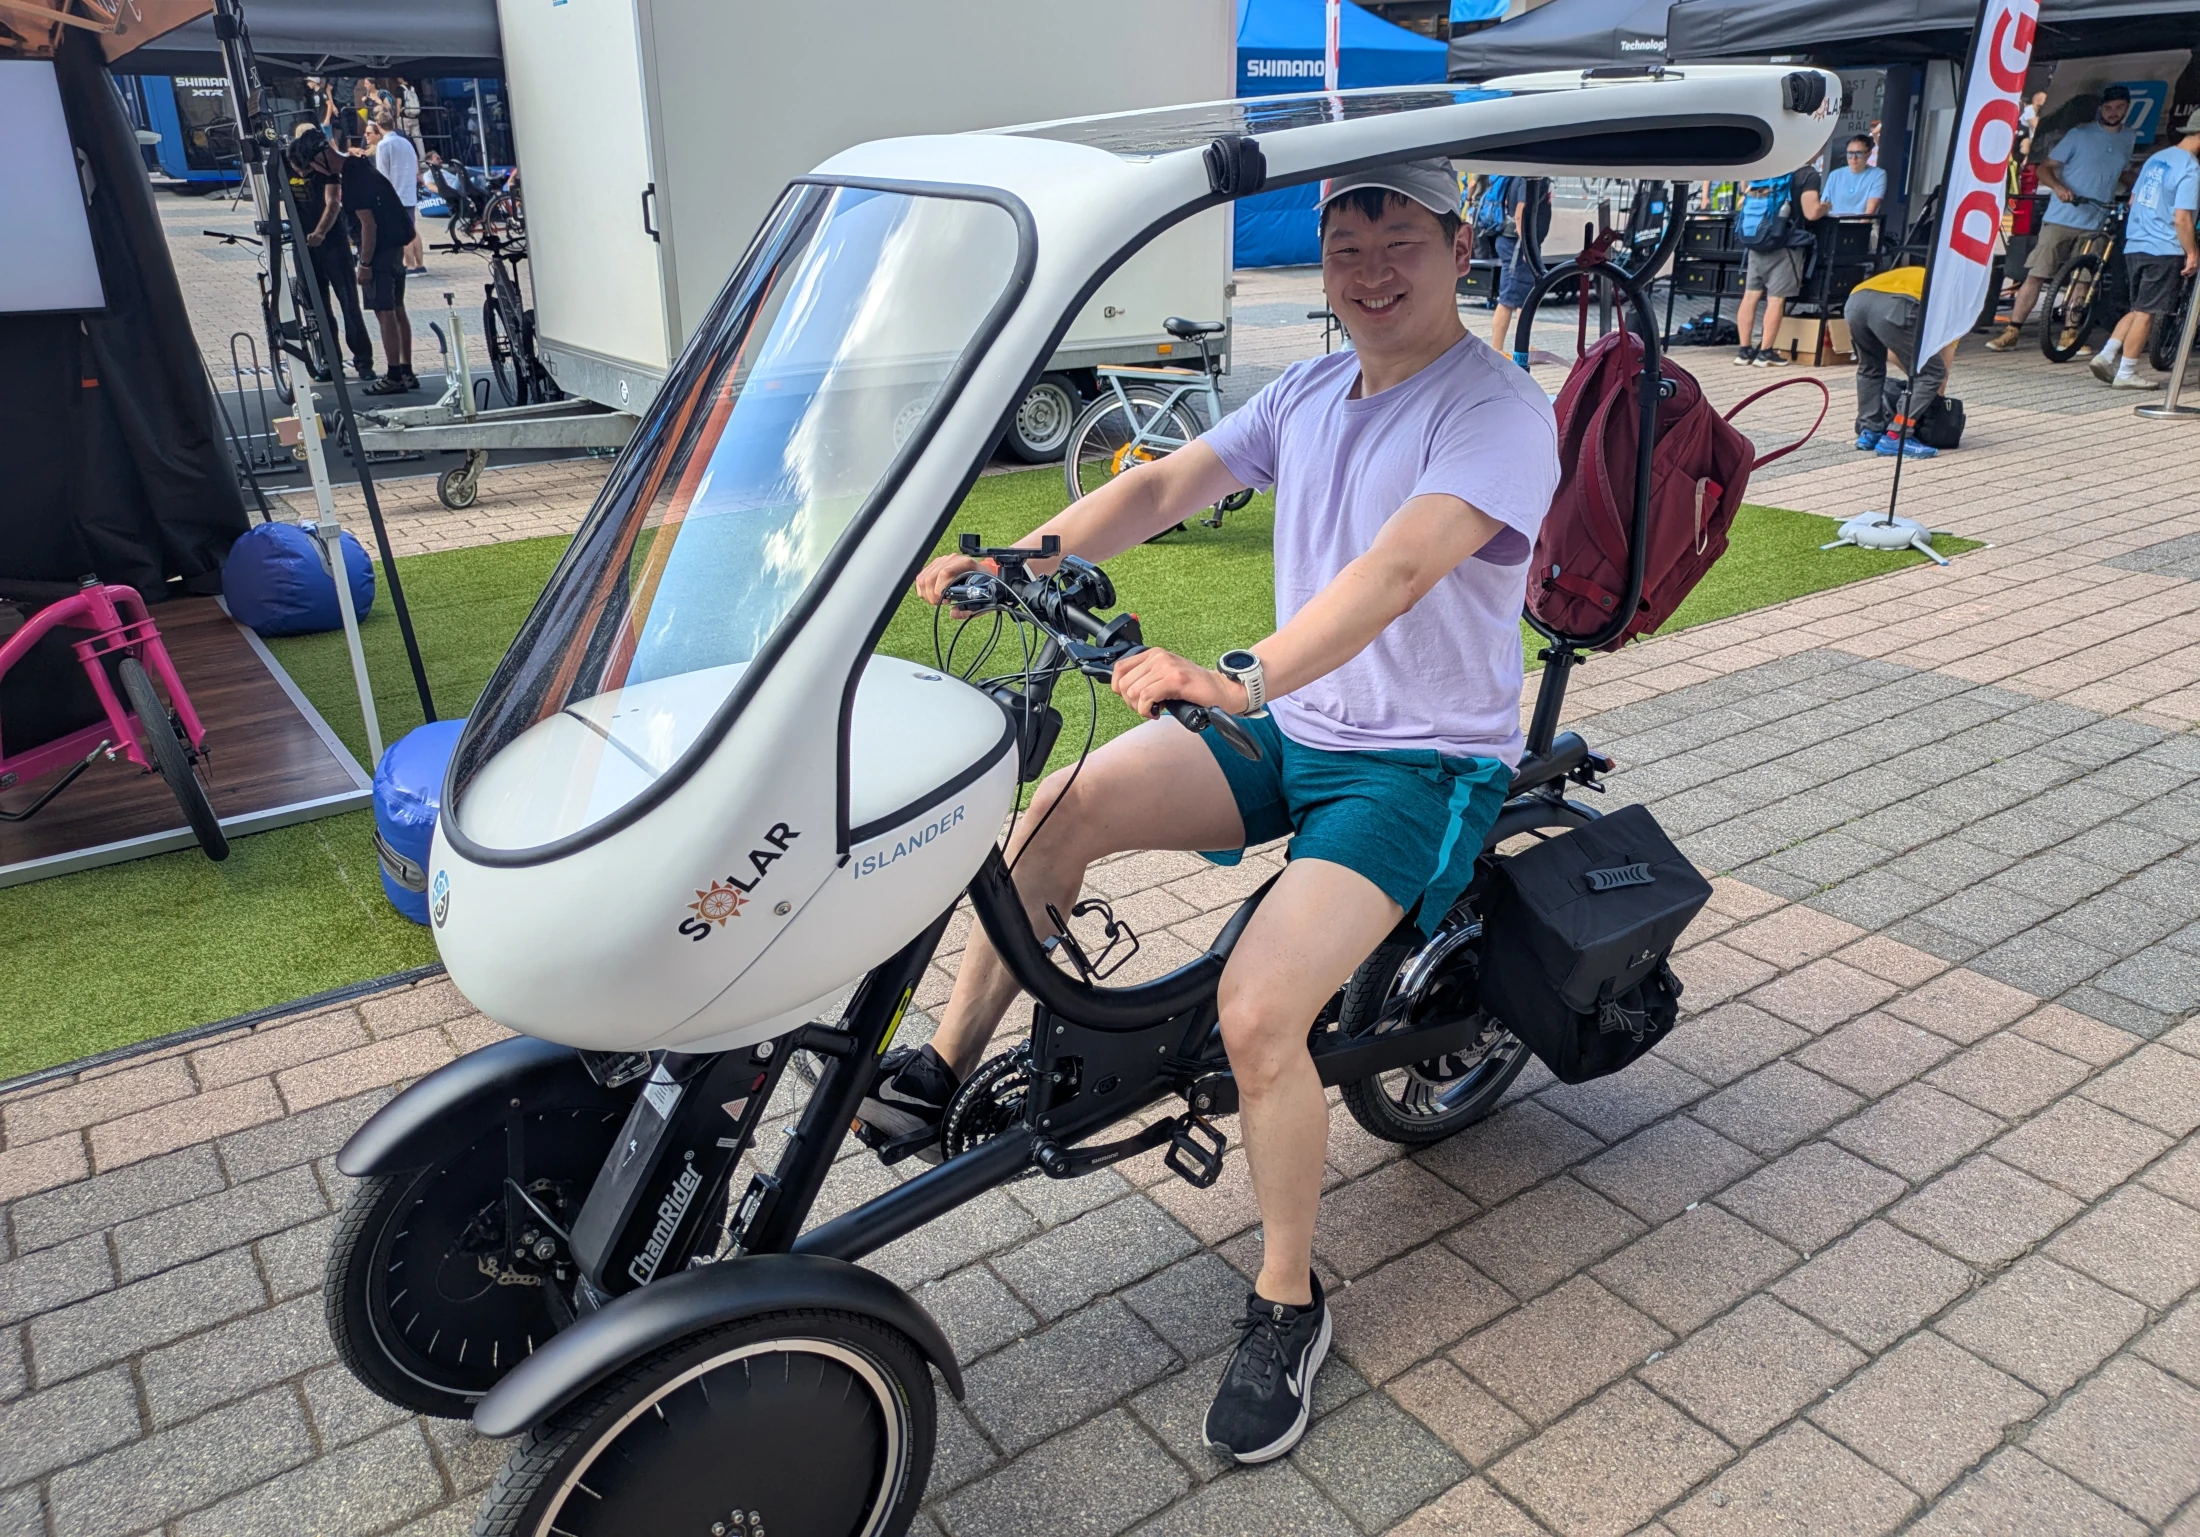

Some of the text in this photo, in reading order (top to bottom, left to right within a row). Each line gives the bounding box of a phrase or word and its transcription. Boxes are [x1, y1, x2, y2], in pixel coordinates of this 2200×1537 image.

[1246, 59, 1325, 77] SHIMANO
[192, 89, 224, 97] XTR
[1848, 121, 1869, 132] RAL
[1949, 0, 2041, 267] DOG
[854, 804, 965, 880] ISLANDER
[678, 822, 802, 942] SOLAR
[1091, 1151, 1119, 1165] SHIMANO
